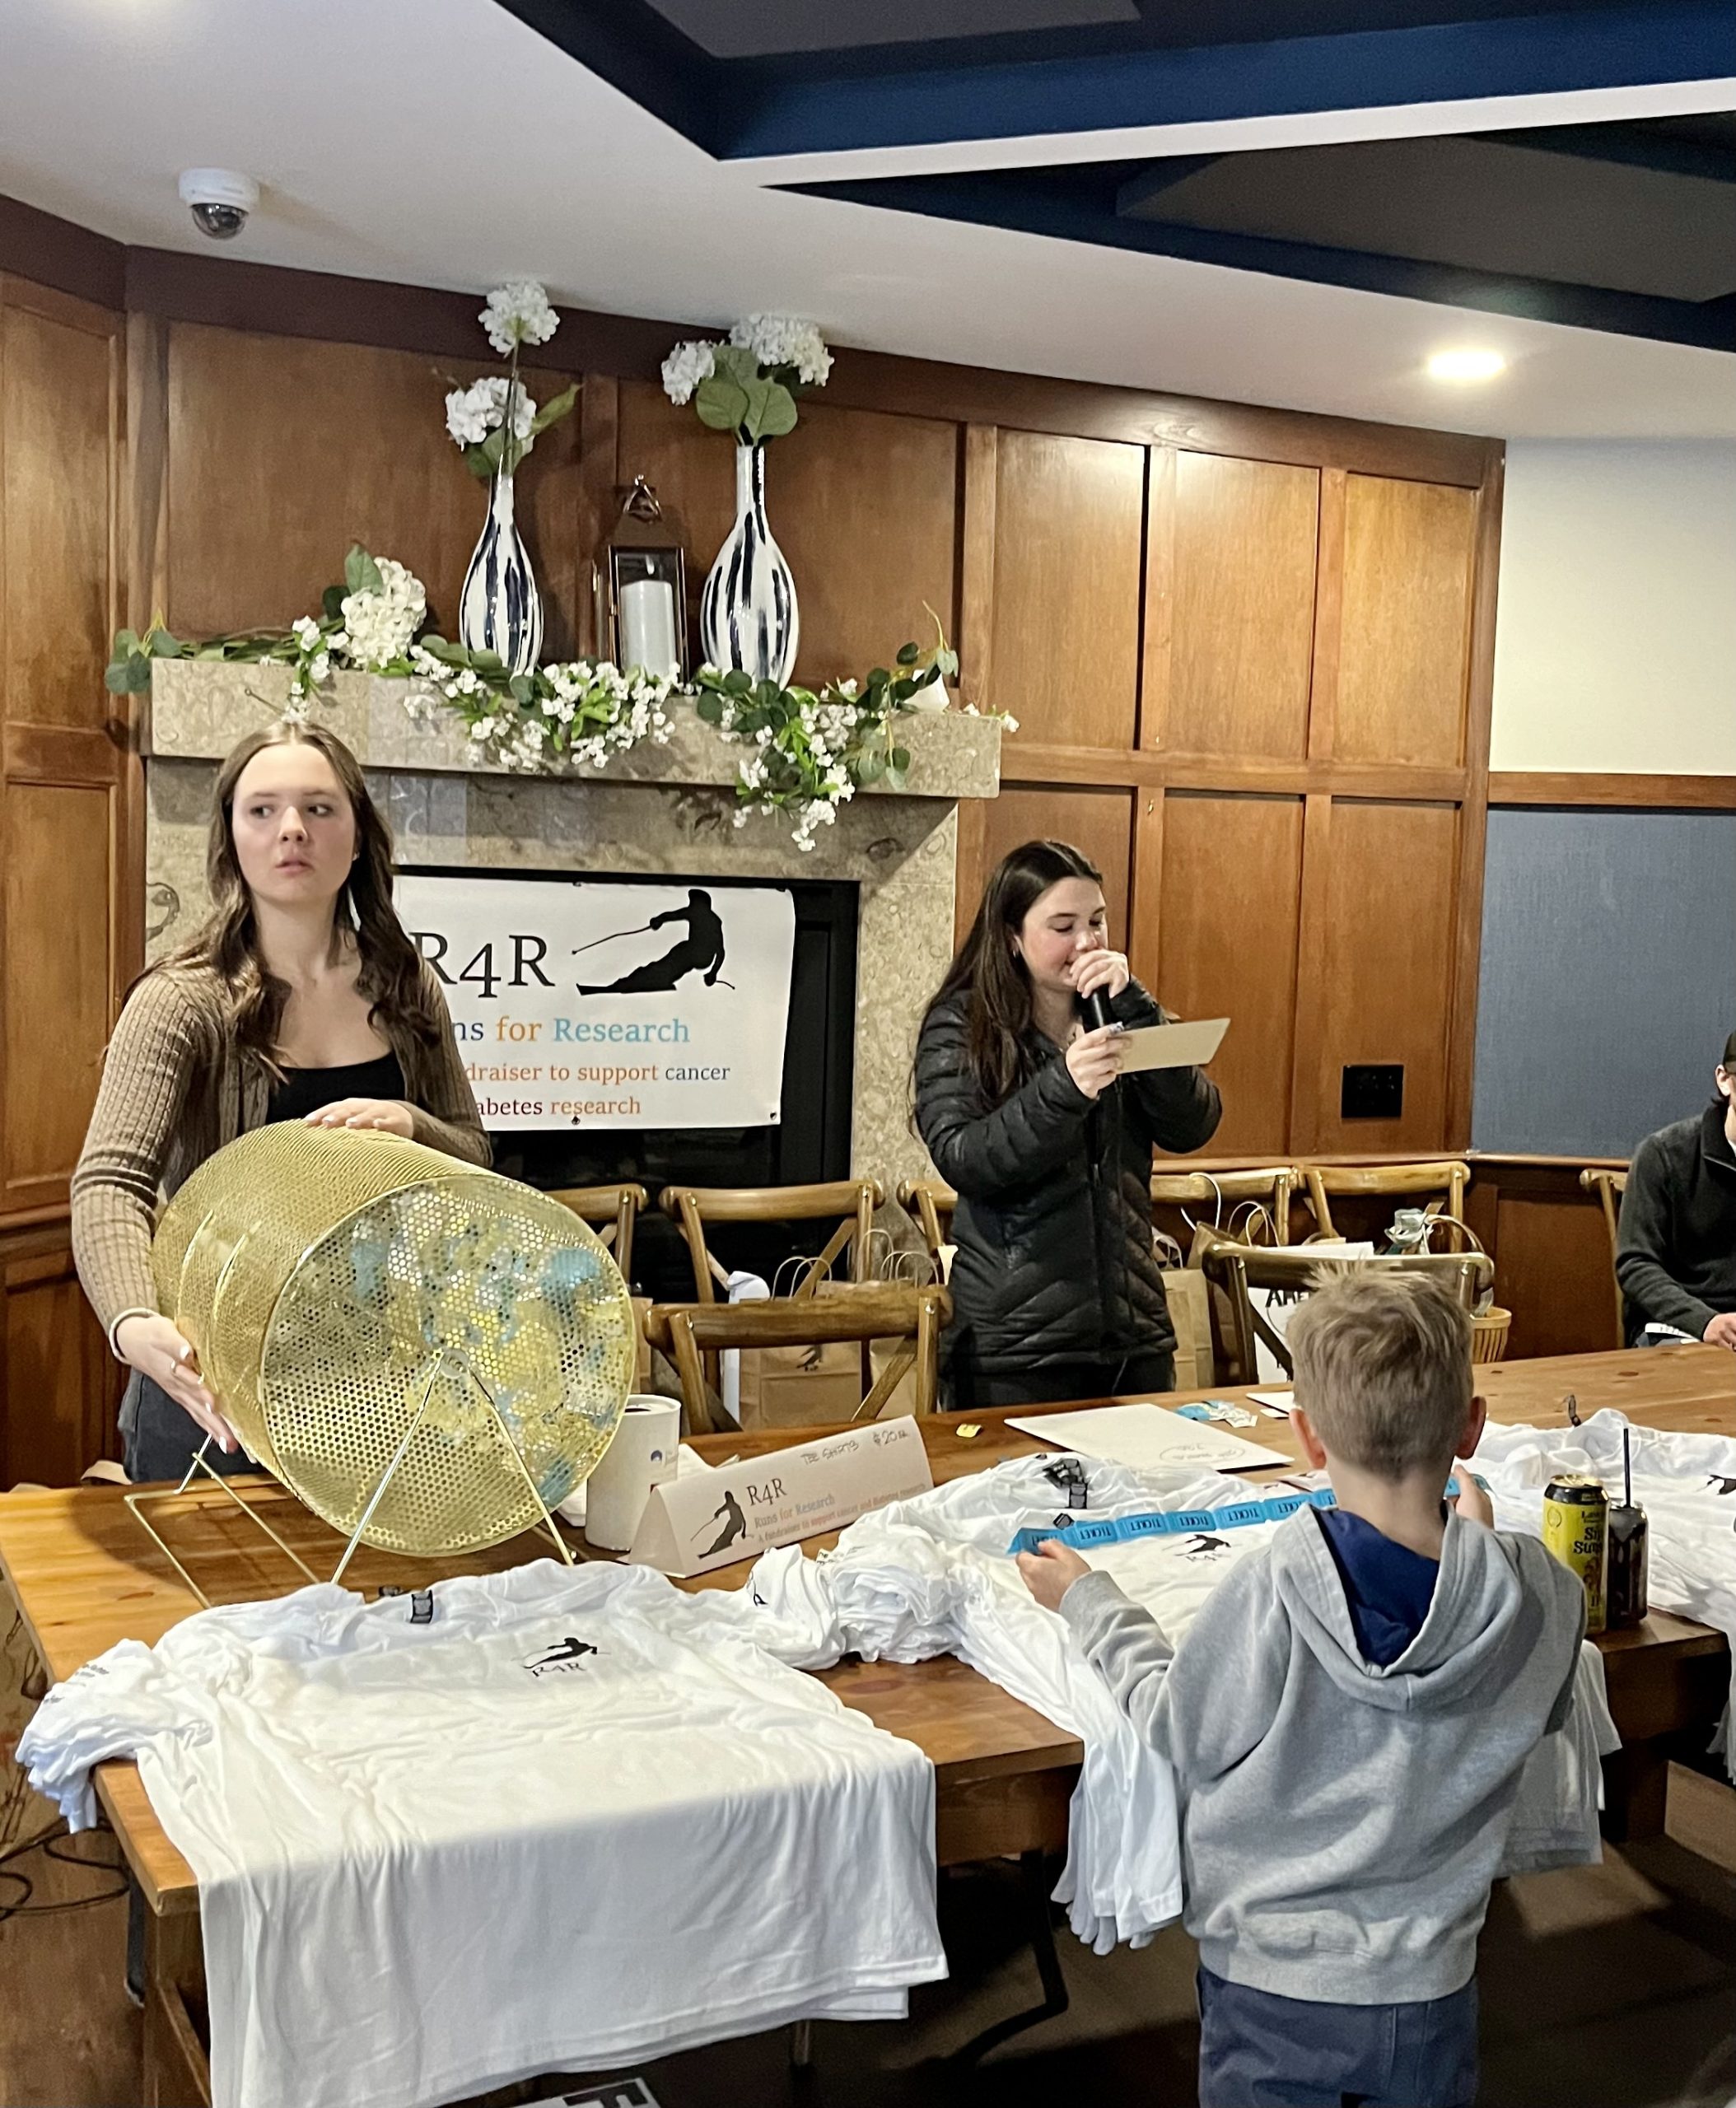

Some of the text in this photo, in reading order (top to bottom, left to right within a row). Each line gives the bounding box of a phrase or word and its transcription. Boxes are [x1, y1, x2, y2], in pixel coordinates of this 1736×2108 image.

[408, 931, 556, 998] R4R
[452, 1014, 690, 1043] ns for Research
[466, 1062, 731, 1085] draiser to support cancer
[477, 1096, 641, 1116] abetes research
[746, 1477, 787, 1506] R4R
[754, 1494, 836, 1529] Runs for Research
[1228, 1507, 1259, 1522] TICKET
[1277, 1501, 1301, 1514] CKET
[1130, 1518, 1162, 1532] TICKET
[1179, 1515, 1209, 1527] TICKET
[1080, 1525, 1112, 1540] TICKET
